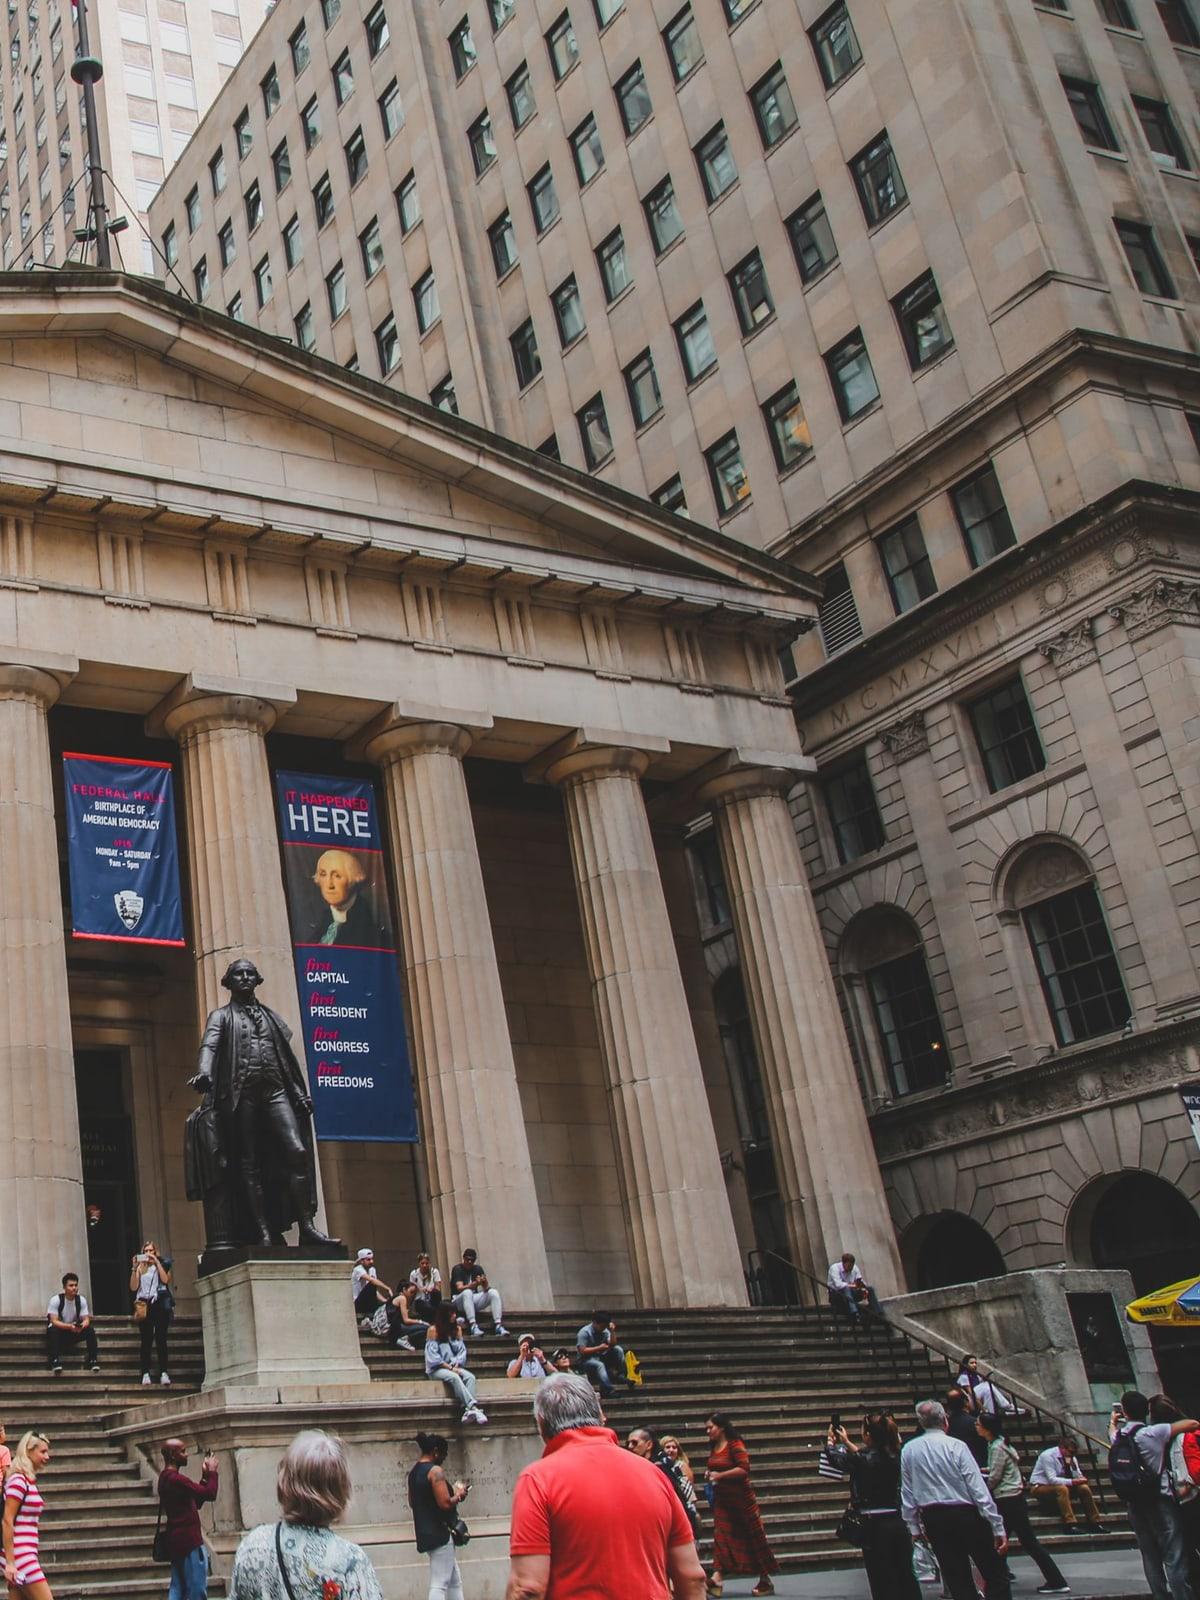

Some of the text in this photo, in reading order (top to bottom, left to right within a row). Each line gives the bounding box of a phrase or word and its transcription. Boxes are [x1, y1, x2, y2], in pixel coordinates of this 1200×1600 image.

[72, 784, 166, 804] FEDERAL HALL
[285, 791, 369, 811] IT HAPPENED
[94, 801, 146, 815] BIRTHPLACE OF
[82, 814, 160, 831] AMERICAN DEMOCRACY
[288, 804, 372, 839] HERE
[95, 847, 118, 857] MONDAY
[123, 849, 152, 860] SATURDAY
[108, 859, 121, 868] 9am
[305, 957, 332, 972] first
[306, 972, 349, 984] CAPITAL
[309, 991, 336, 1006] first
[310, 1006, 368, 1020] PRESIDENT
[312, 1026, 340, 1041] first
[314, 1040, 370, 1053] CONGRESS
[316, 1060, 343, 1075] first
[317, 1076, 374, 1089] FREEDOMS
